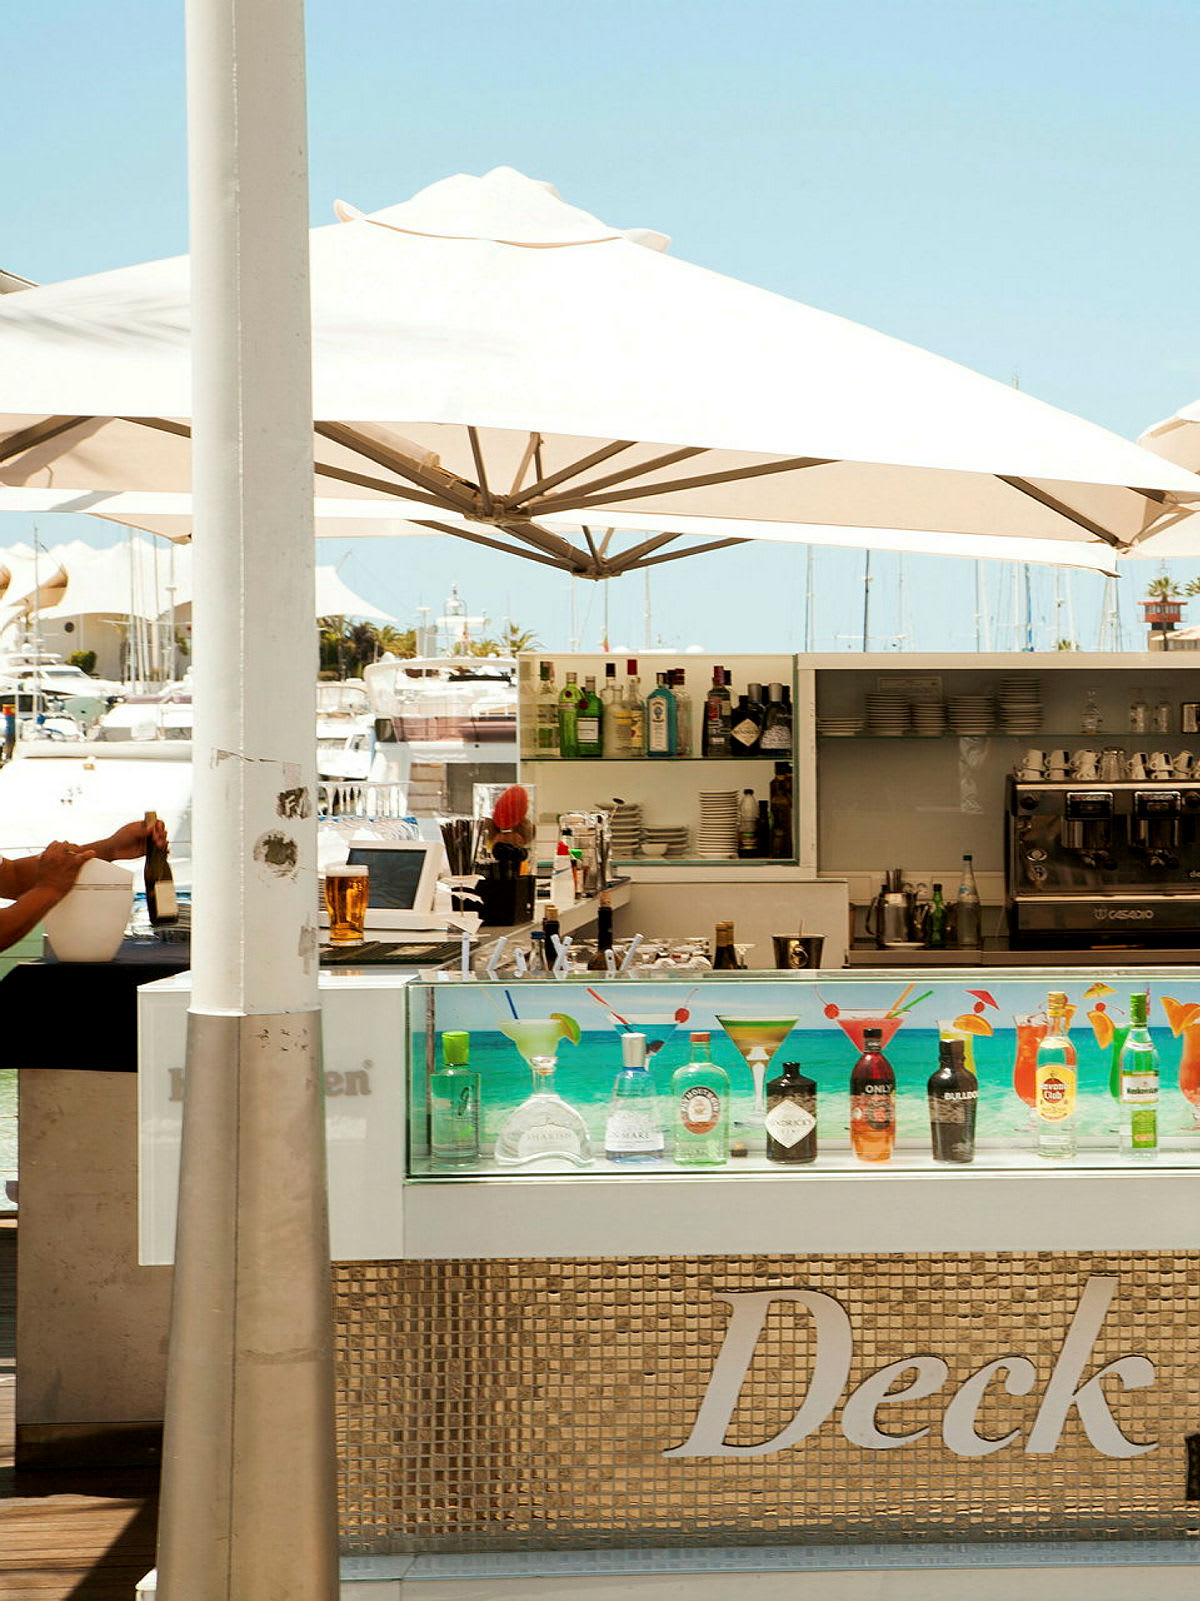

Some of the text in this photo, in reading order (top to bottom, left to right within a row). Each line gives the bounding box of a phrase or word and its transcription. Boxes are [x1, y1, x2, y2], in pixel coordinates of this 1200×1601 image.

[864, 1084, 893, 1094] ONLY
[943, 1090, 979, 1101] BULLDO
[662, 1275, 1158, 1458] Deck
